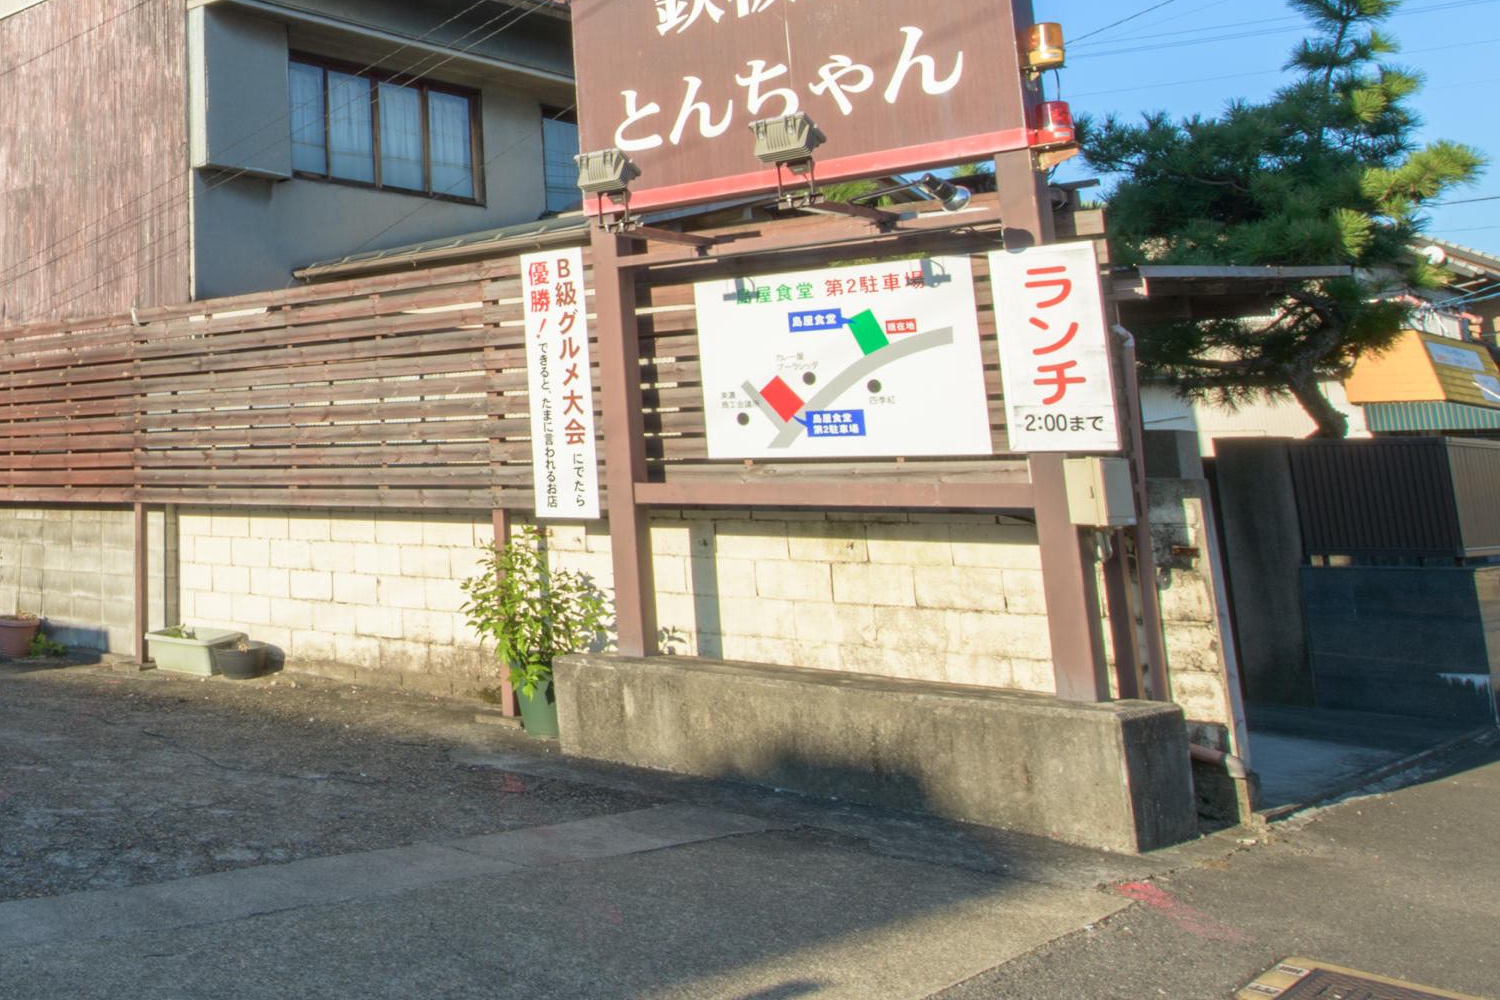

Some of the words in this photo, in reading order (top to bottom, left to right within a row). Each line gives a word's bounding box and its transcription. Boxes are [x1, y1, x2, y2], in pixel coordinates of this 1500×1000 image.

[613, 26, 964, 152] とんちゃん
[791, 313, 838, 328] 島屋食堂
[886, 321, 916, 332] 現在地
[1024, 265, 1087, 406] ランチ
[812, 413, 853, 424] 島屋食堂
[1024, 413, 1104, 432] 2:00まで
[813, 424, 860, 435] 第2駐車場
